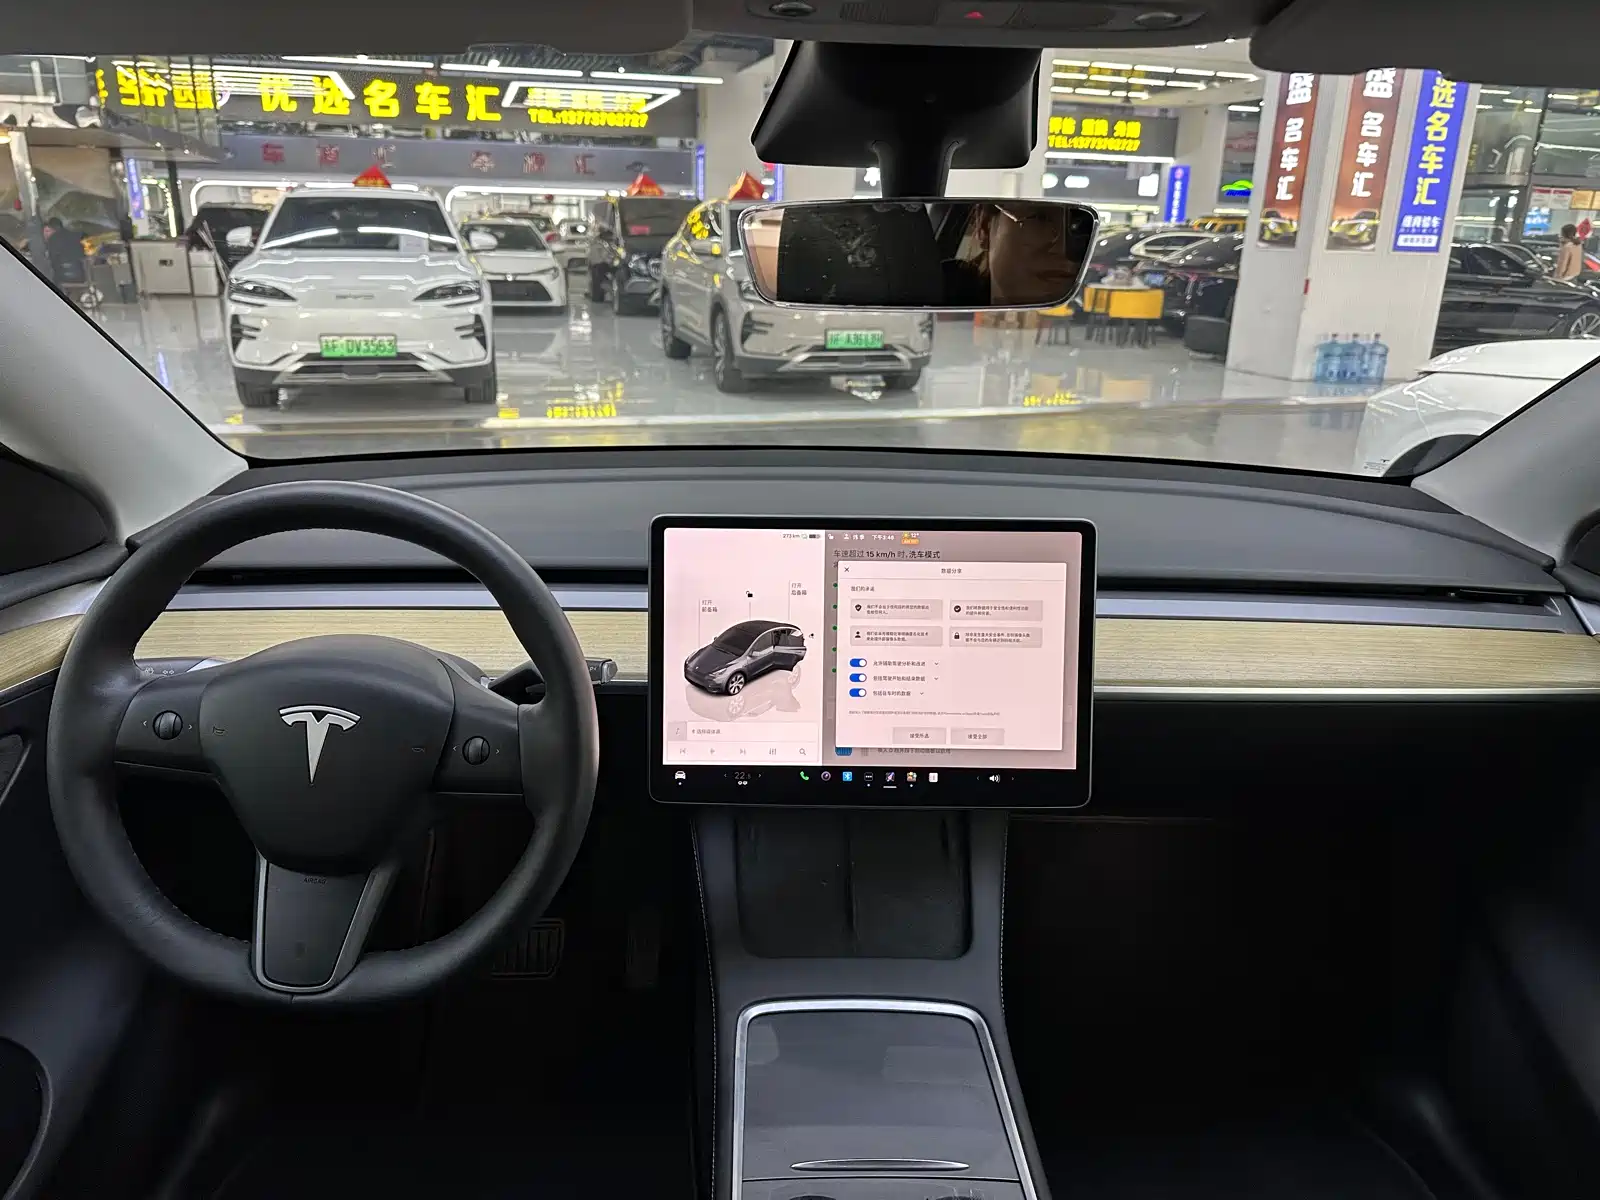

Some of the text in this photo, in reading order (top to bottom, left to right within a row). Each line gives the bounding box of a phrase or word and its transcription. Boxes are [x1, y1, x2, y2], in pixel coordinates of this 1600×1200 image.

[1412, 70, 1457, 206] 选名车汇
[833, 550, 865, 558] 车速超过
[866, 550, 875, 558] 15
[876, 550, 896, 558] km/h
